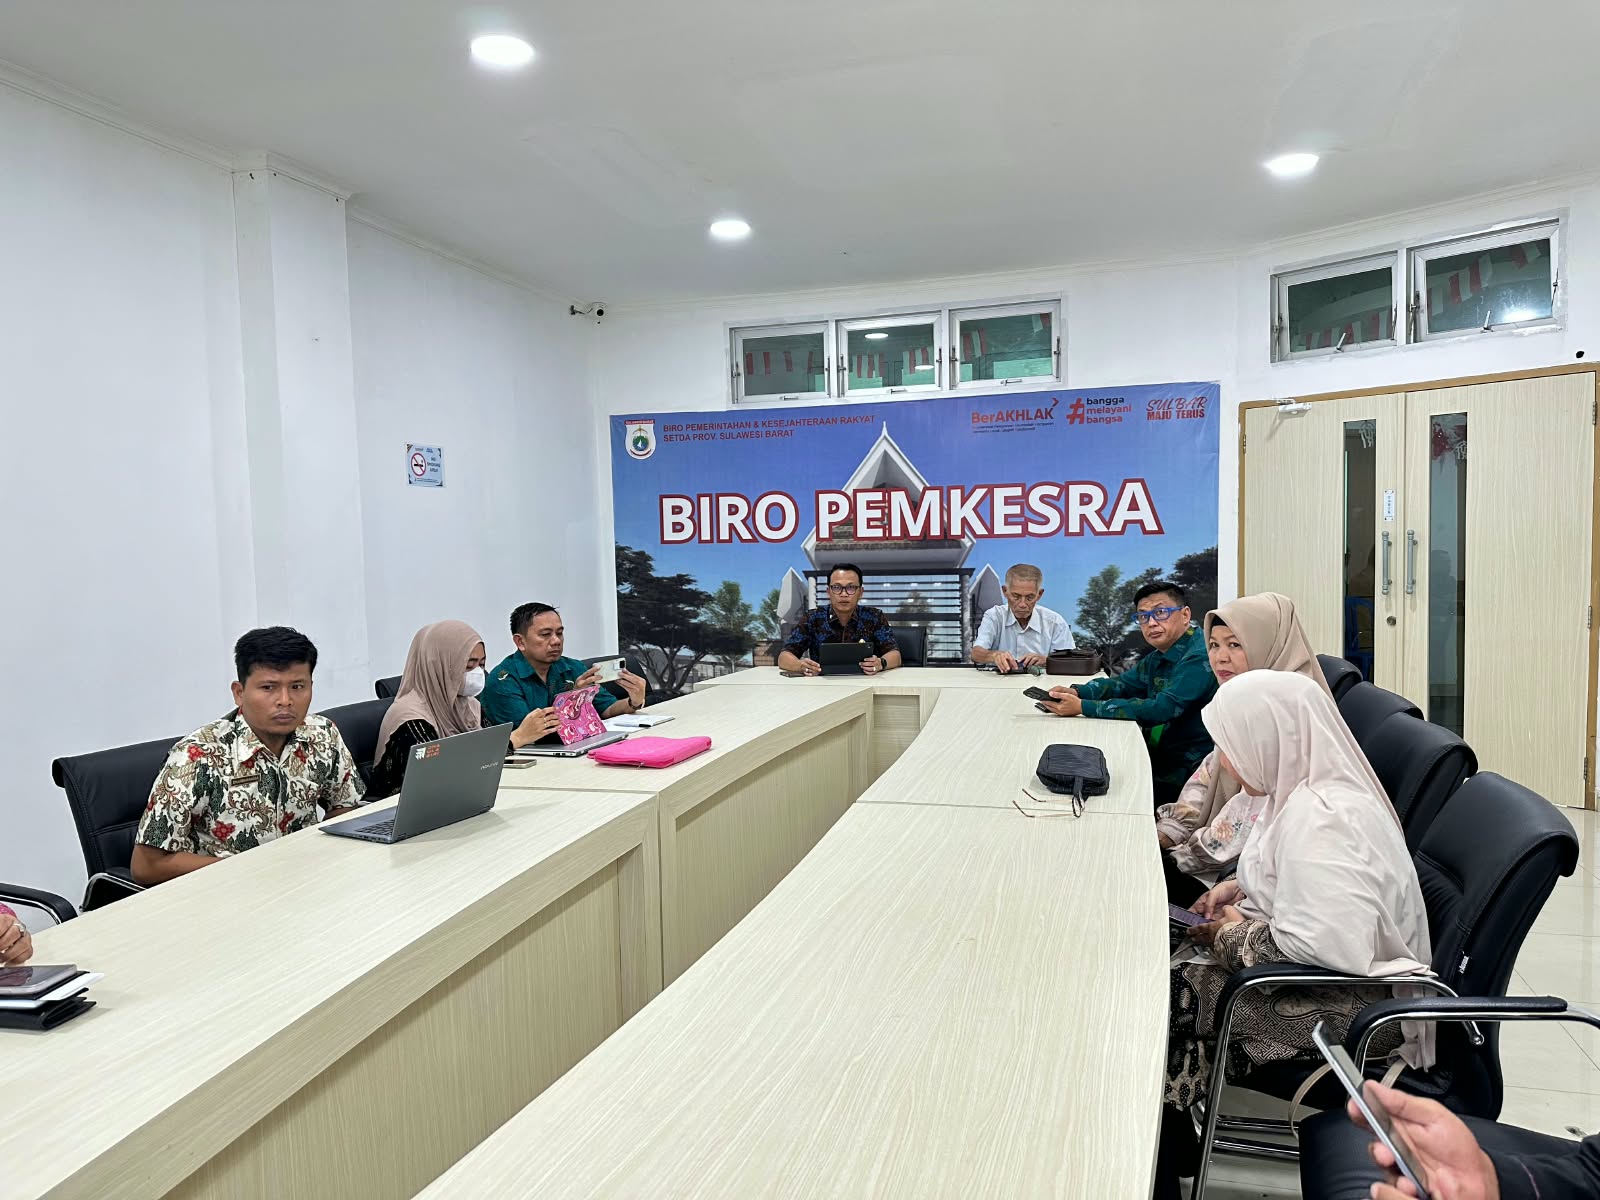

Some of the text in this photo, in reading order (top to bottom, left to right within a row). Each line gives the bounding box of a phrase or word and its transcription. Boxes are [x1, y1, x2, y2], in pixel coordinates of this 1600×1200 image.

[1086, 397, 1125, 406] bangga
[971, 407, 1055, 424] BerAKHLAK
[1086, 404, 1132, 415] melayani
[1147, 408, 1205, 421] MAJU TERUS
[663, 414, 876, 432] BIRO PEMERINTAHAN & KESEJAHTERAAN RAKYAT
[1086, 415, 1123, 424] bangsa
[663, 433, 691, 442] SETDA
[719, 430, 763, 440] SULAWESI
[765, 429, 795, 438] BARAT
[659, 478, 1166, 544] BIRO PEMKESRA
